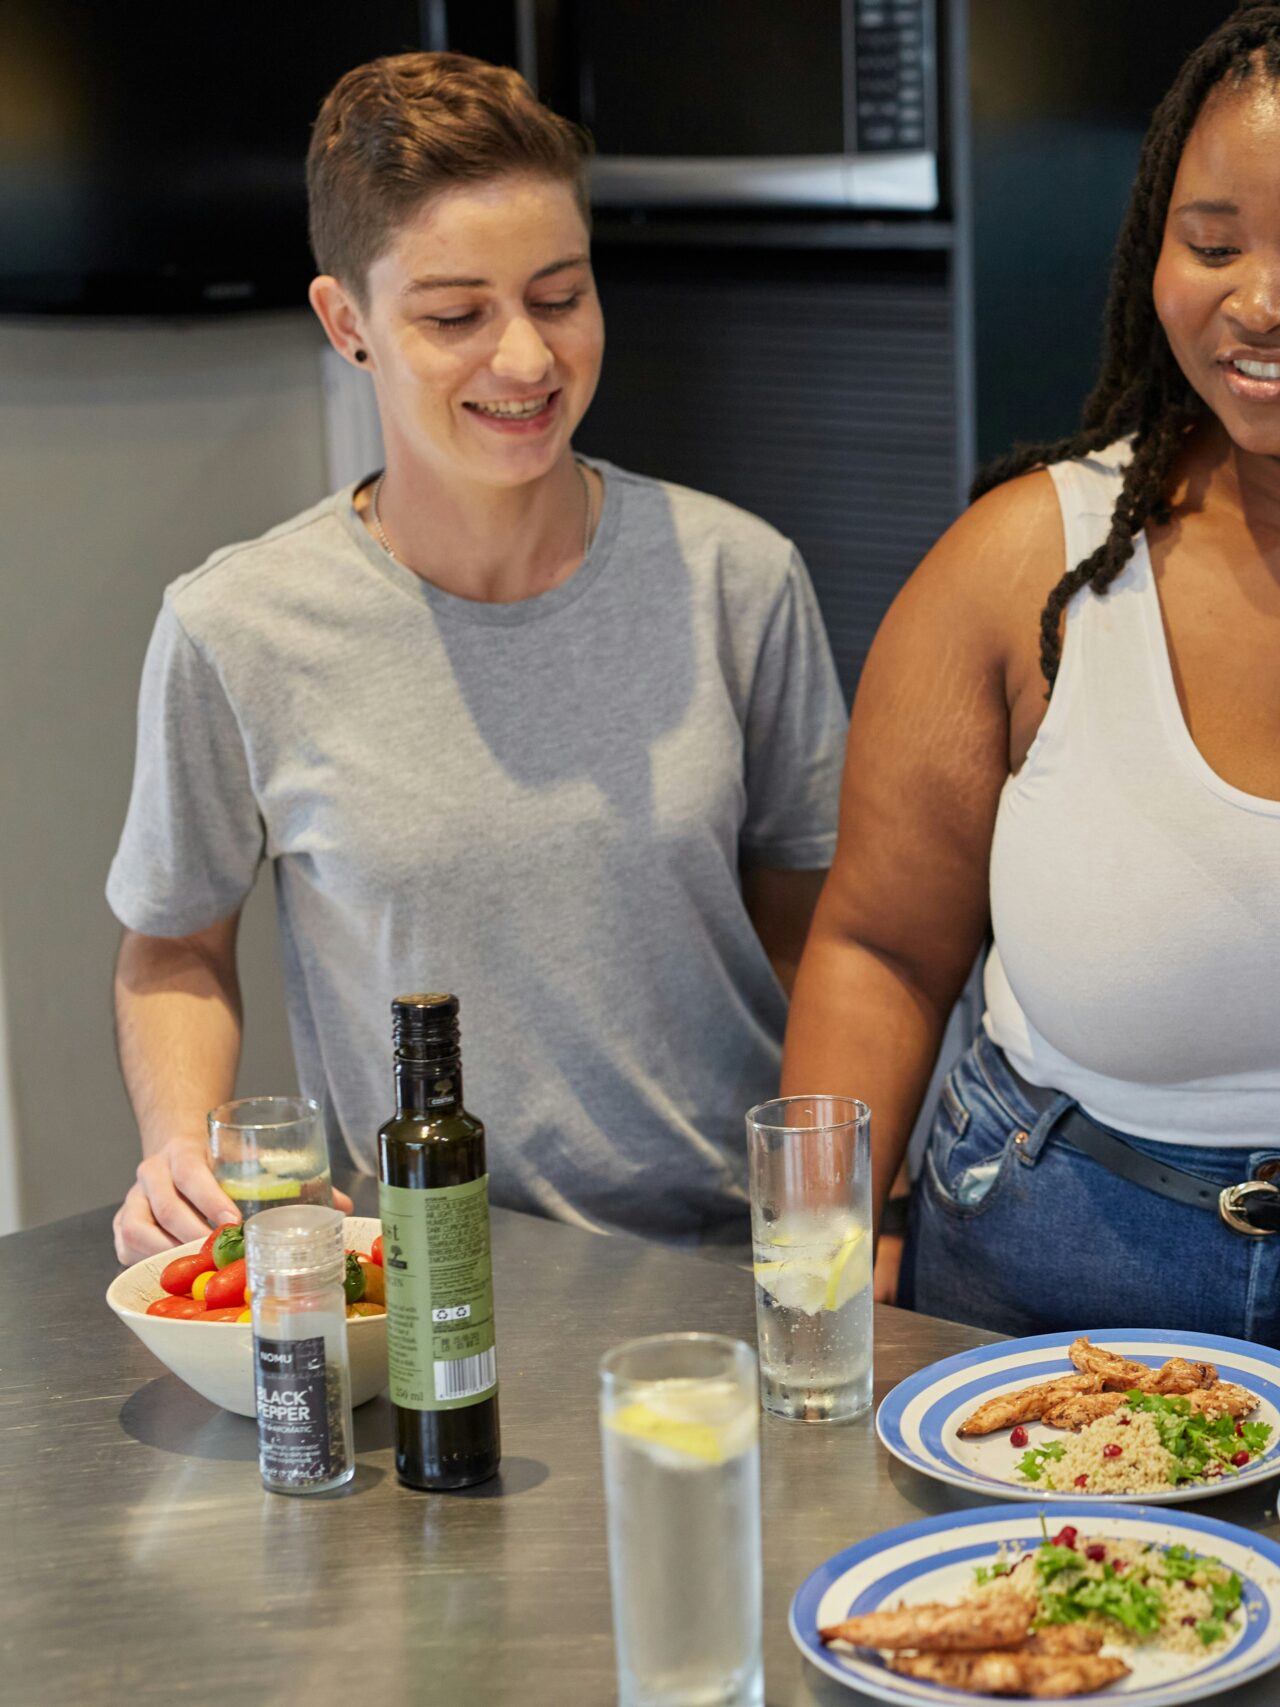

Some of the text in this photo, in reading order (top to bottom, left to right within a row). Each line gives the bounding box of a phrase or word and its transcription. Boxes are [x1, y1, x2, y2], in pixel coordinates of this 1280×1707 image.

[260, 1351, 294, 1364] NOMU
[410, 1391, 424, 1401] ml
[257, 1401, 311, 1421] PEPPER
